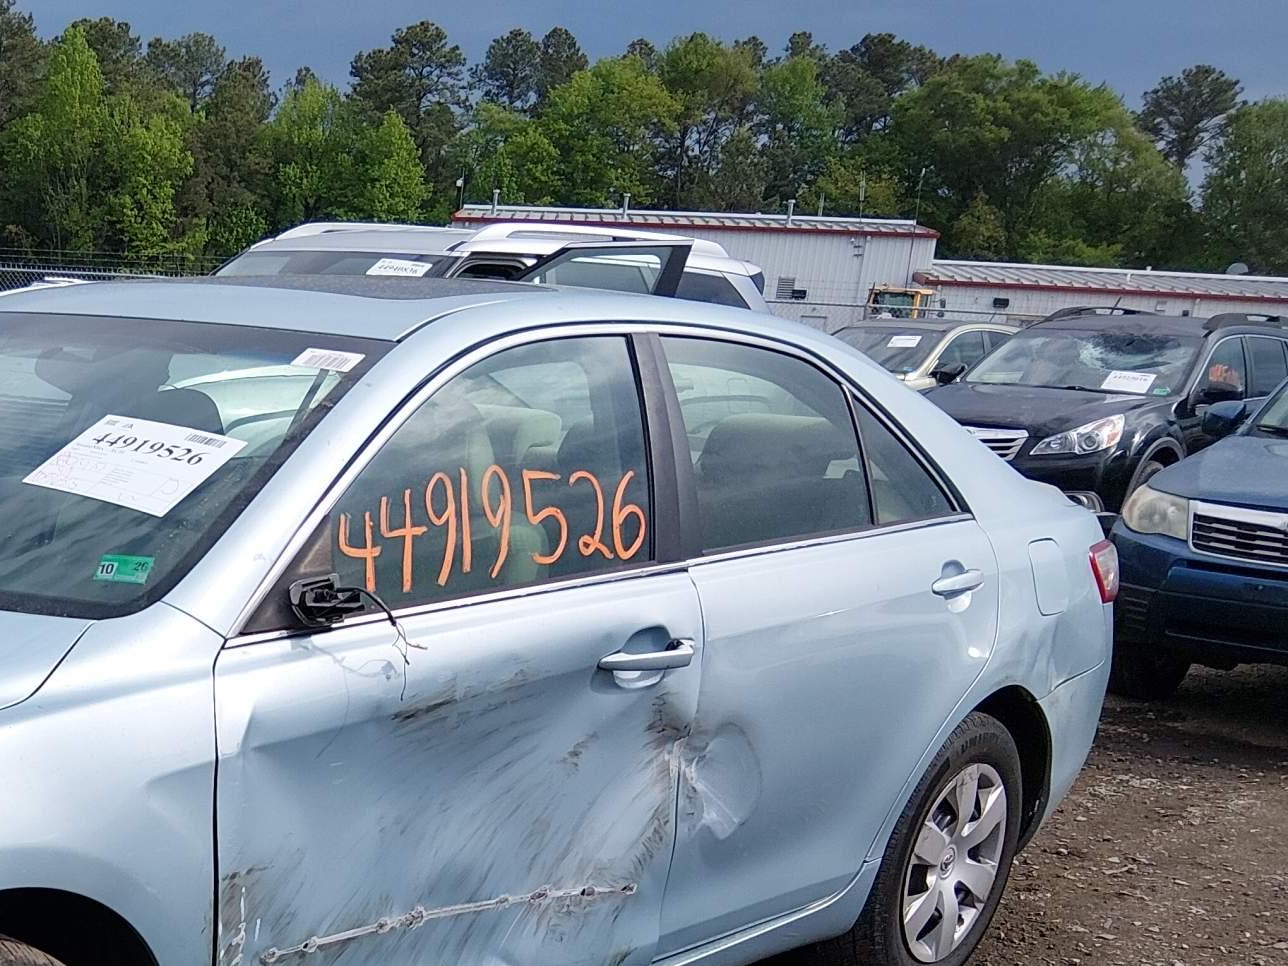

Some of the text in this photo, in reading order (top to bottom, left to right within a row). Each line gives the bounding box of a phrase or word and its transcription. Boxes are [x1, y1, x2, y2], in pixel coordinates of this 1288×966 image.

[92, 432, 208, 466] 44919526
[338, 464, 647, 593] 44919526
[100, 563, 114, 575] 10
